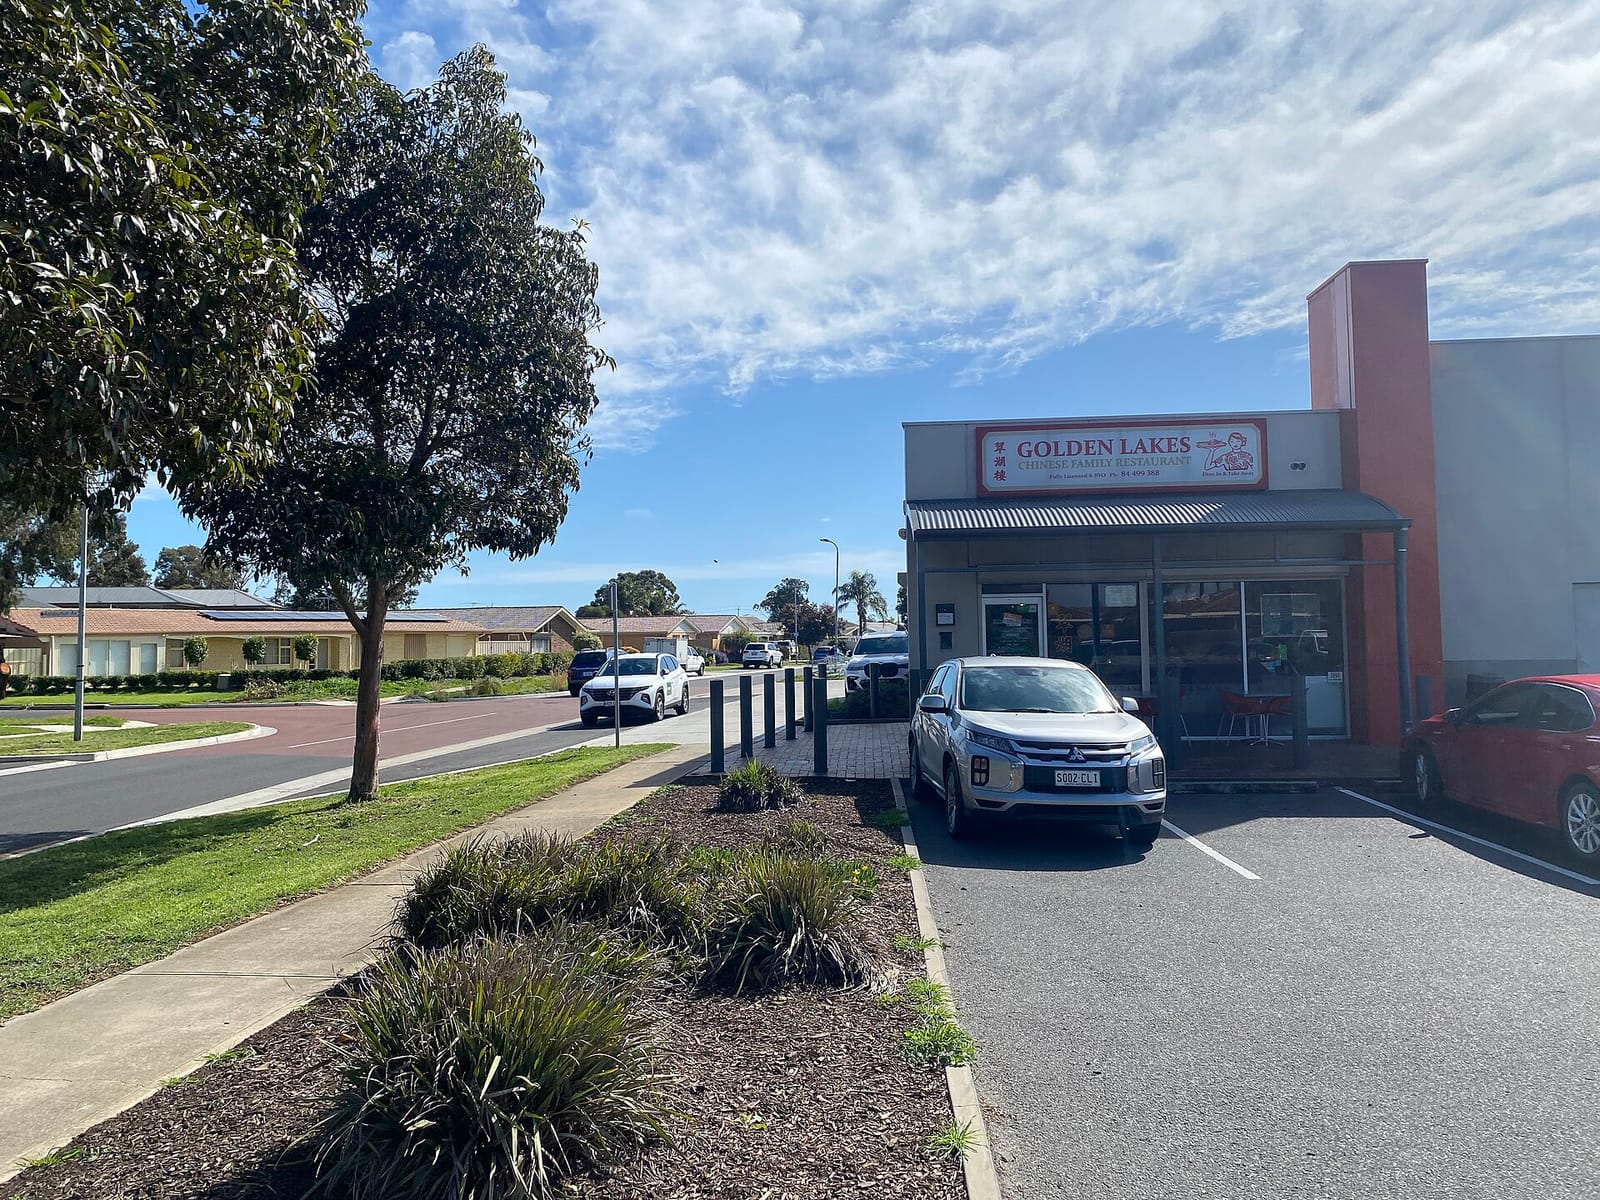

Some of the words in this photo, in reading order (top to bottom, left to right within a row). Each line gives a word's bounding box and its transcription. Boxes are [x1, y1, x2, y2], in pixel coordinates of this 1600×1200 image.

[1016, 439, 1114, 458] GOLDEN
[1119, 436, 1191, 455] LAKES
[1017, 459, 1069, 471] CHINESE
[1071, 457, 1113, 469] FAMILY
[1115, 456, 1192, 468] RESTAURANT
[1120, 470, 1131, 478] 84
[1132, 469, 1146, 477] 499
[1147, 468, 1160, 476] 388
